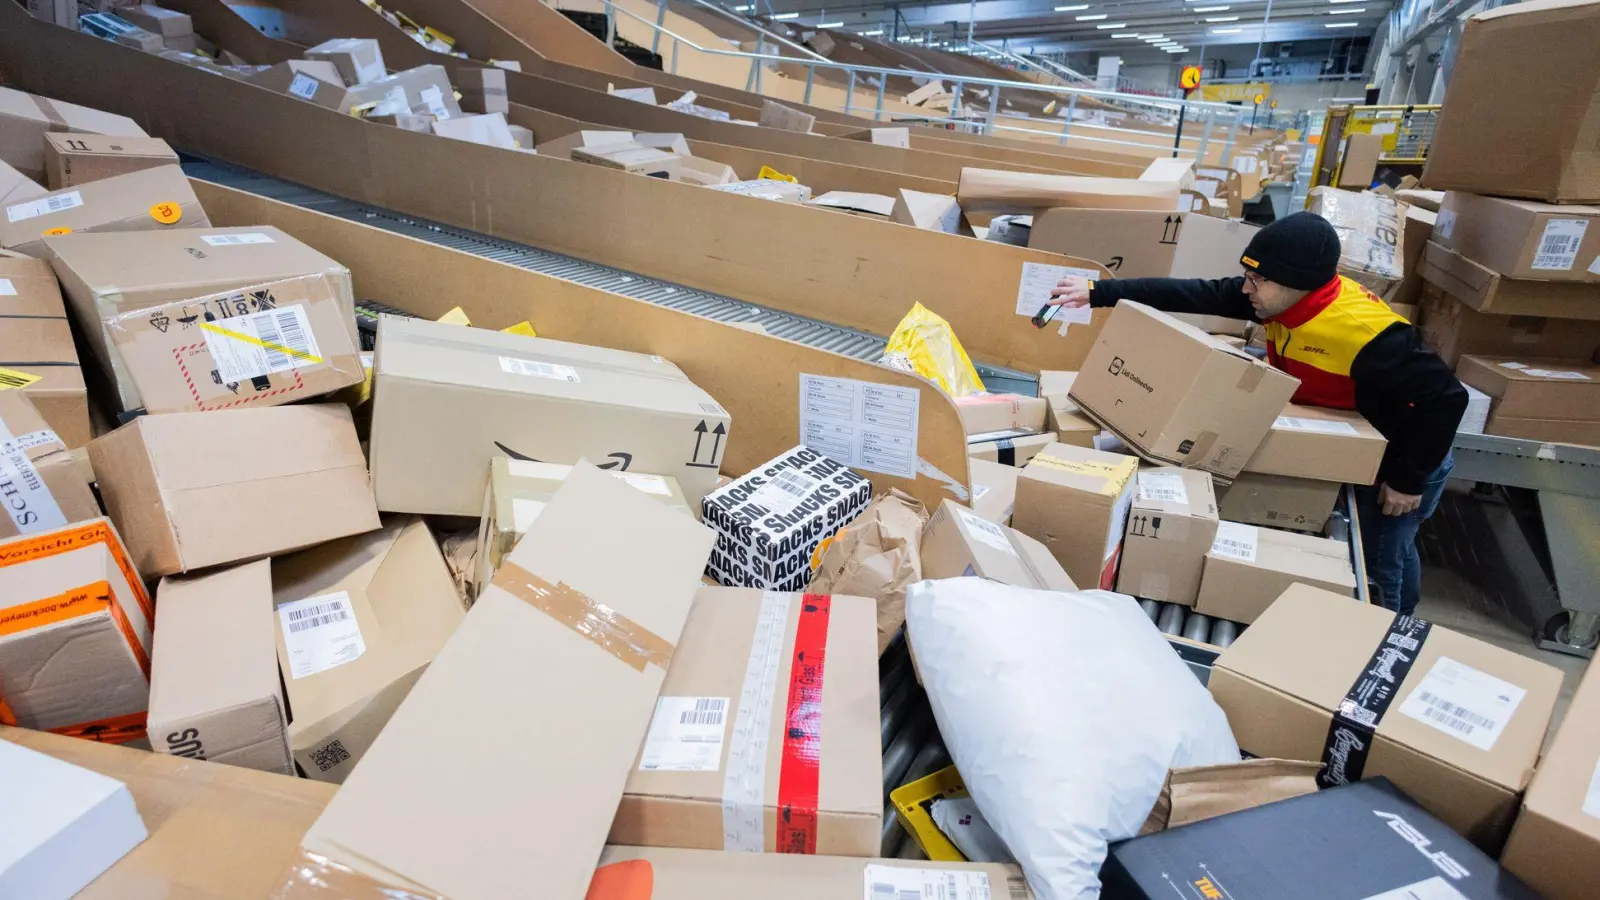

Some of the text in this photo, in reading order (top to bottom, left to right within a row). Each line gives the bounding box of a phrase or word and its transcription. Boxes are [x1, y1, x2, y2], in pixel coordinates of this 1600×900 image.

[1121, 368, 1154, 394] Lidl Onlineshop
[715, 477, 768, 511] ACKS
[764, 483, 841, 534] SNACKS
[0, 538, 73, 561] Vorsicht
[1371, 810, 1471, 880] ASUS
[1195, 876, 1224, 900] TUF
